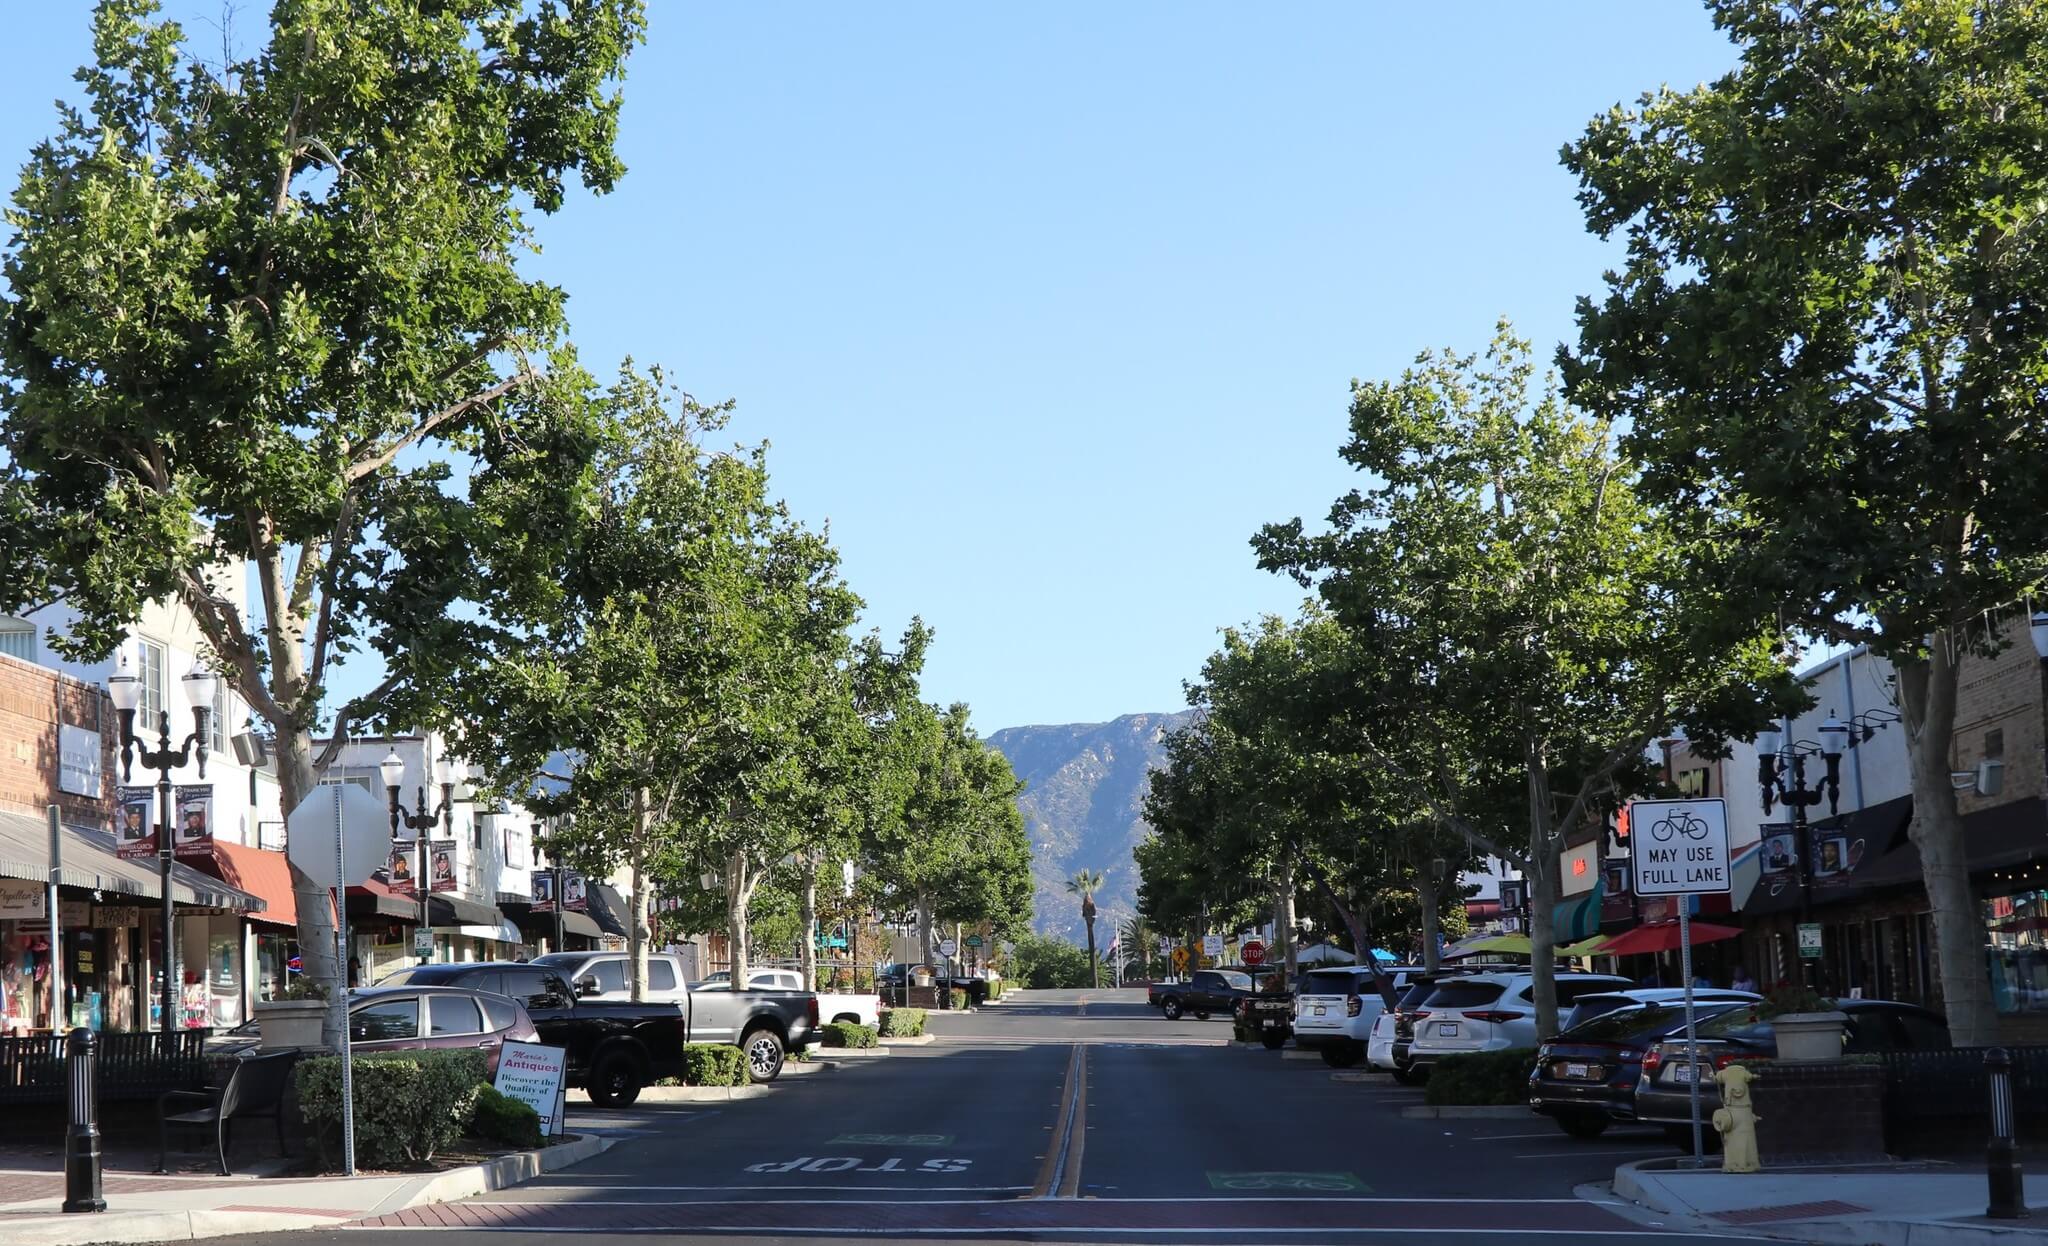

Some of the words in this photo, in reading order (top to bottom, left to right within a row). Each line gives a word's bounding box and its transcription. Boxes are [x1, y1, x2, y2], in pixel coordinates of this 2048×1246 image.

[1649, 849, 1678, 863] MAY
[1687, 847, 1714, 862] USE
[1643, 870, 1679, 885] FULL
[1686, 867, 1723, 882] LANE
[1243, 950, 1264, 958] STOP
[512, 1050, 548, 1061] Maria's
[504, 1059, 559, 1072] Antiques
[501, 1073, 539, 1084] Discover
[504, 1084, 536, 1094] Quality
[539, 1087, 549, 1095] of
[743, 1157, 974, 1173] STOP
